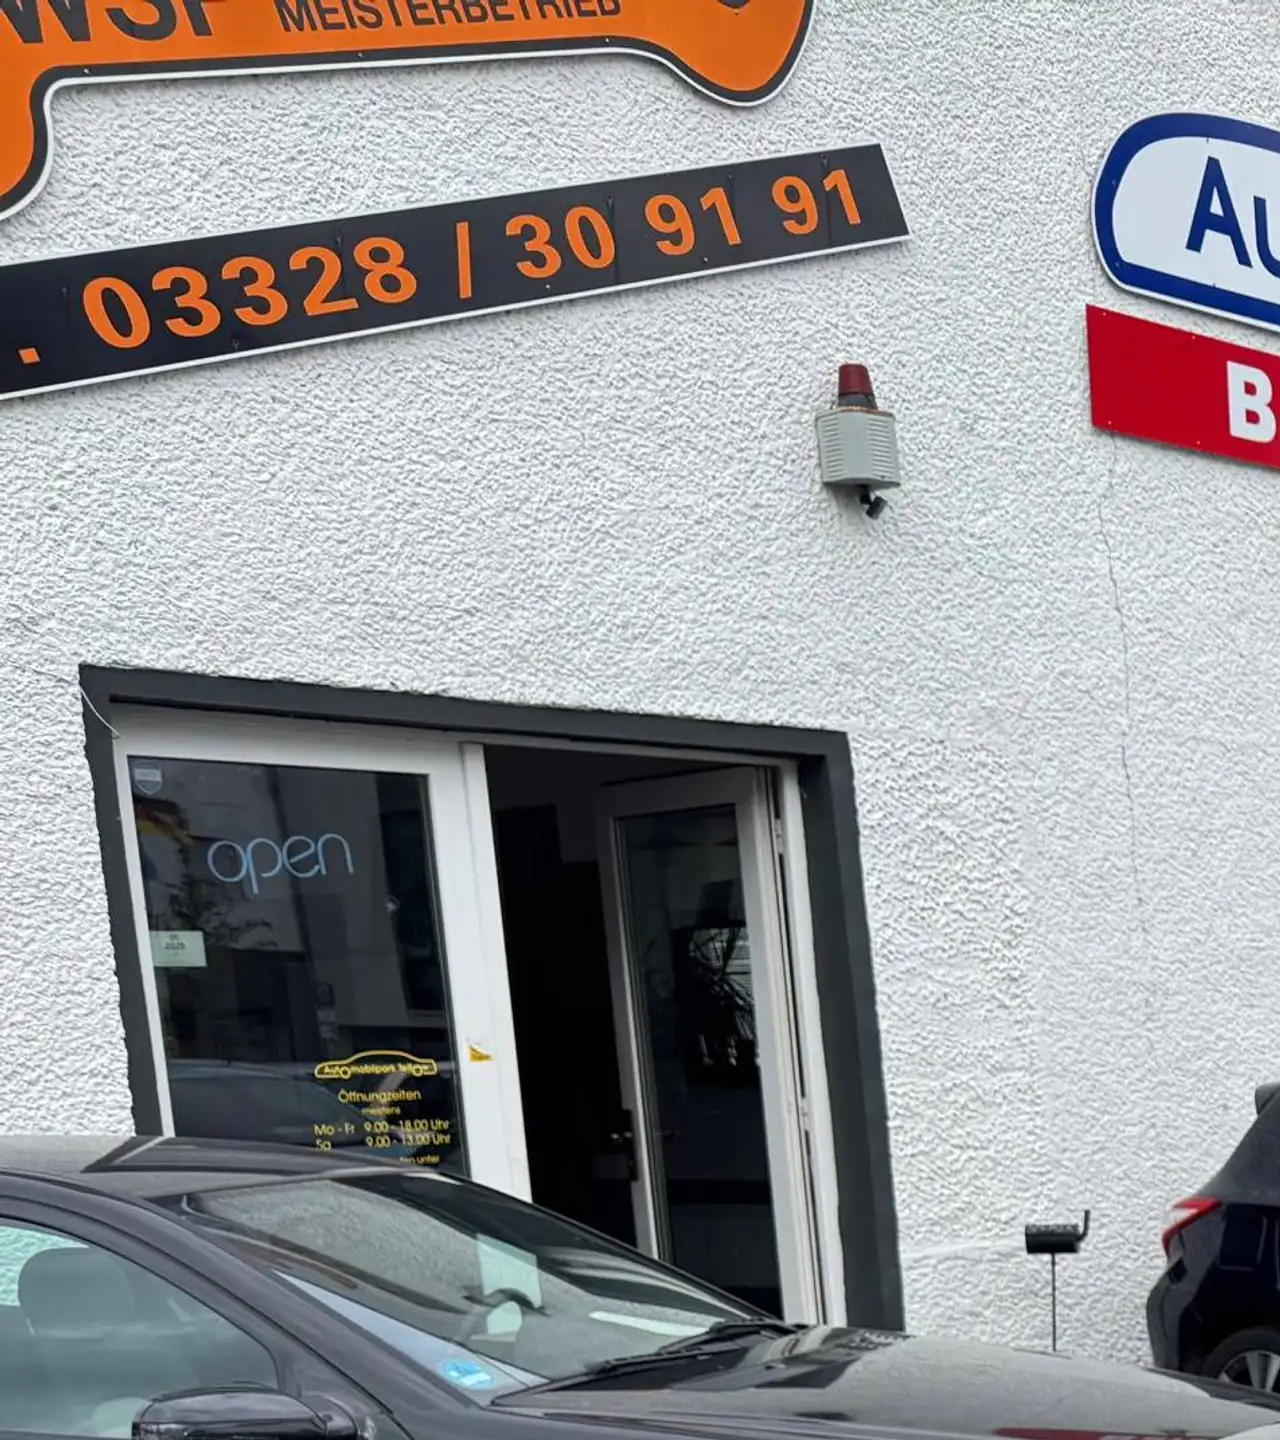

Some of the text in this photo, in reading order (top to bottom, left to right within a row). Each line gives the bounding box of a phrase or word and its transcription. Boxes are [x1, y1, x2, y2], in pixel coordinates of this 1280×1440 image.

[81, 234, 417, 350] 03328
[455, 220, 474, 299] /
[504, 204, 617, 280] 30
[643, 185, 740, 257] 91
[771, 168, 861, 236] 91
[207, 832, 354, 895] open
[314, 1122, 335, 1136] Mo
[364, 1120, 389, 1134] 9.00
[430, 1117, 450, 1131] Uhr
[315, 1138, 333, 1152] Sa
[365, 1135, 391, 1149] 9.00
[432, 1131, 451, 1145] Uhr
